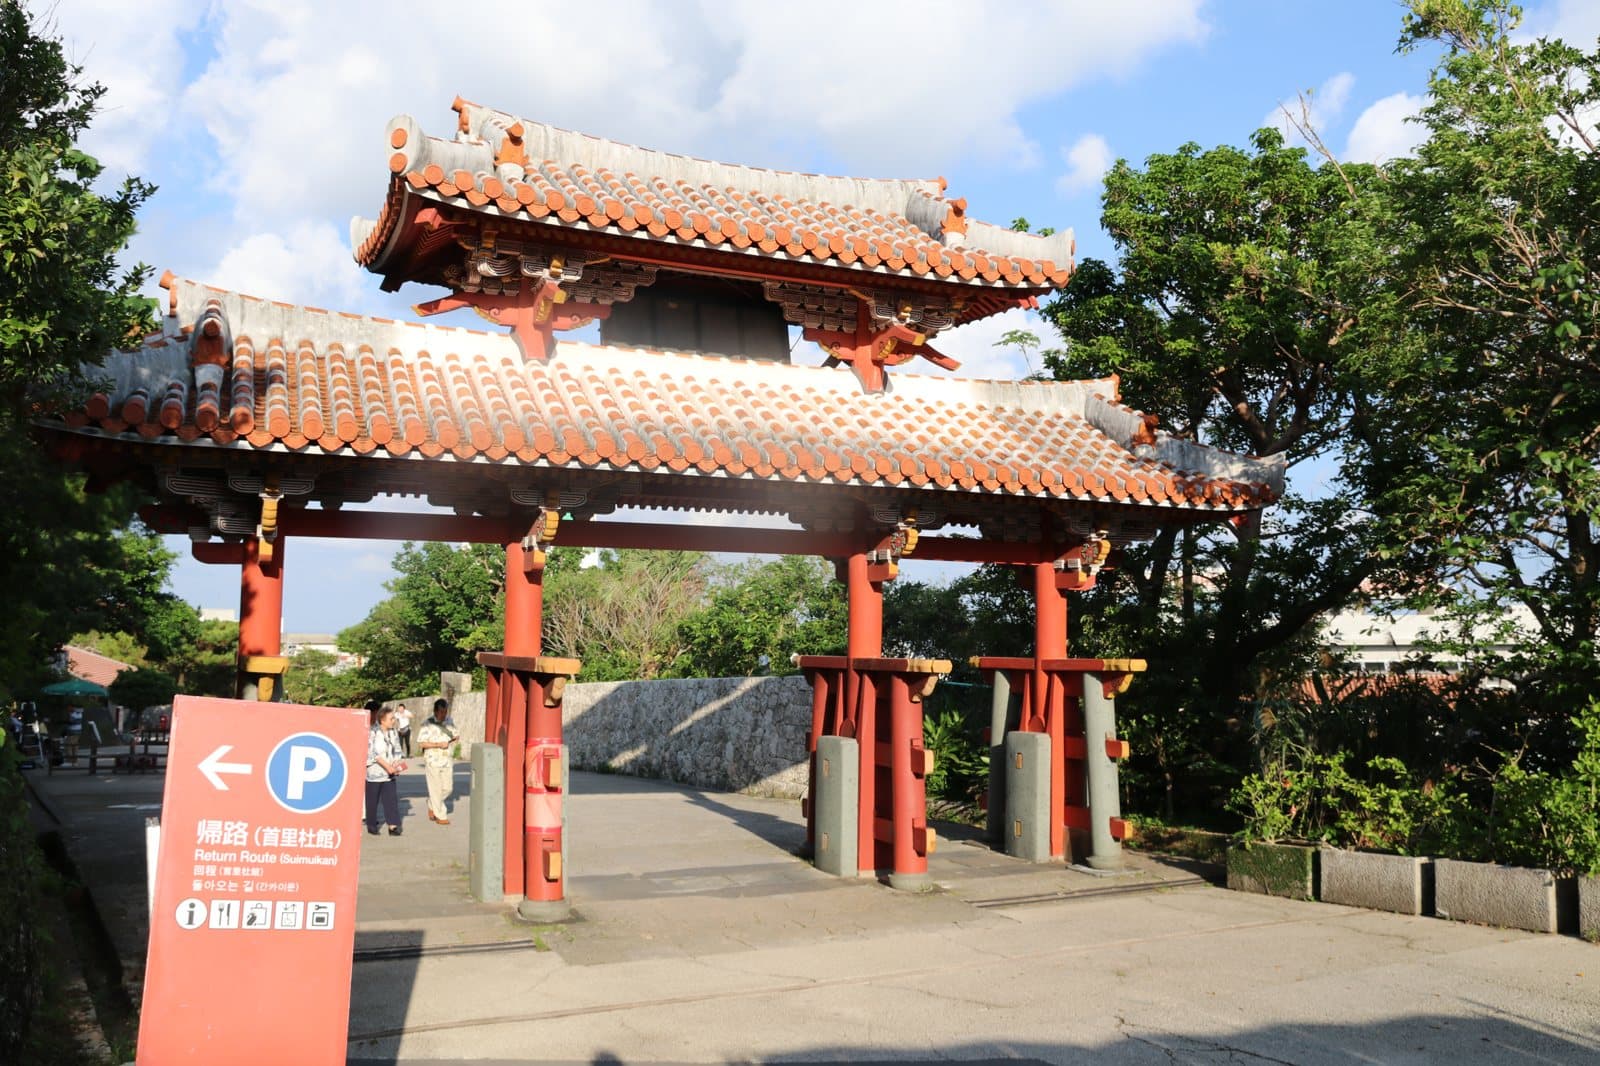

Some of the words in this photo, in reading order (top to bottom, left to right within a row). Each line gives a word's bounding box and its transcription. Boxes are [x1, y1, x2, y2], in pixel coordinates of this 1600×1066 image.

[286, 745, 332, 800] P
[196, 819, 249, 847] 帰路
[194, 848, 237, 862] Return
[240, 850, 277, 864] Route
[279, 853, 338, 866] (Suimuikan)
[192, 879, 239, 892] 돌아오는
[243, 880, 254, 892] 길
